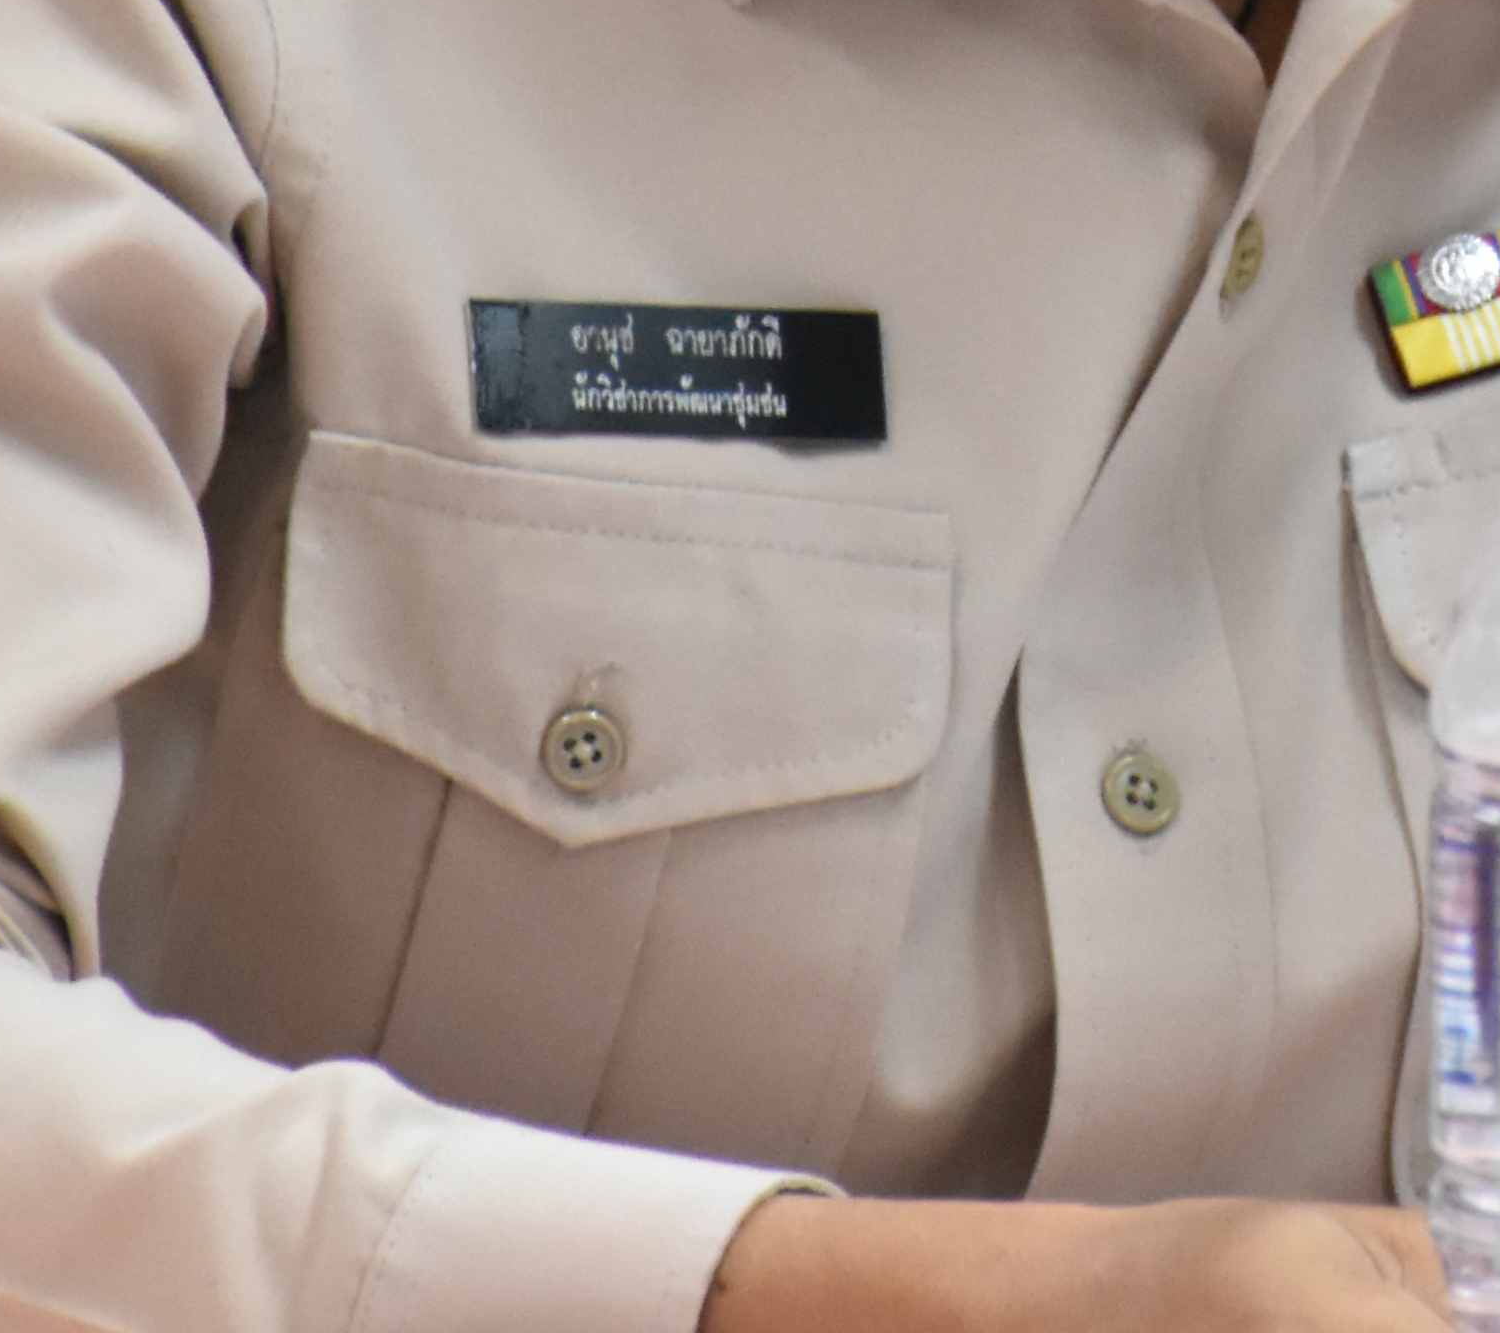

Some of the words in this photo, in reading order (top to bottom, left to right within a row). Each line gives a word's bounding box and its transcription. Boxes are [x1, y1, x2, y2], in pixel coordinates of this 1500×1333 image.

[571, 370, 788, 430] นักวิชาการพัฒนาชุมชน
